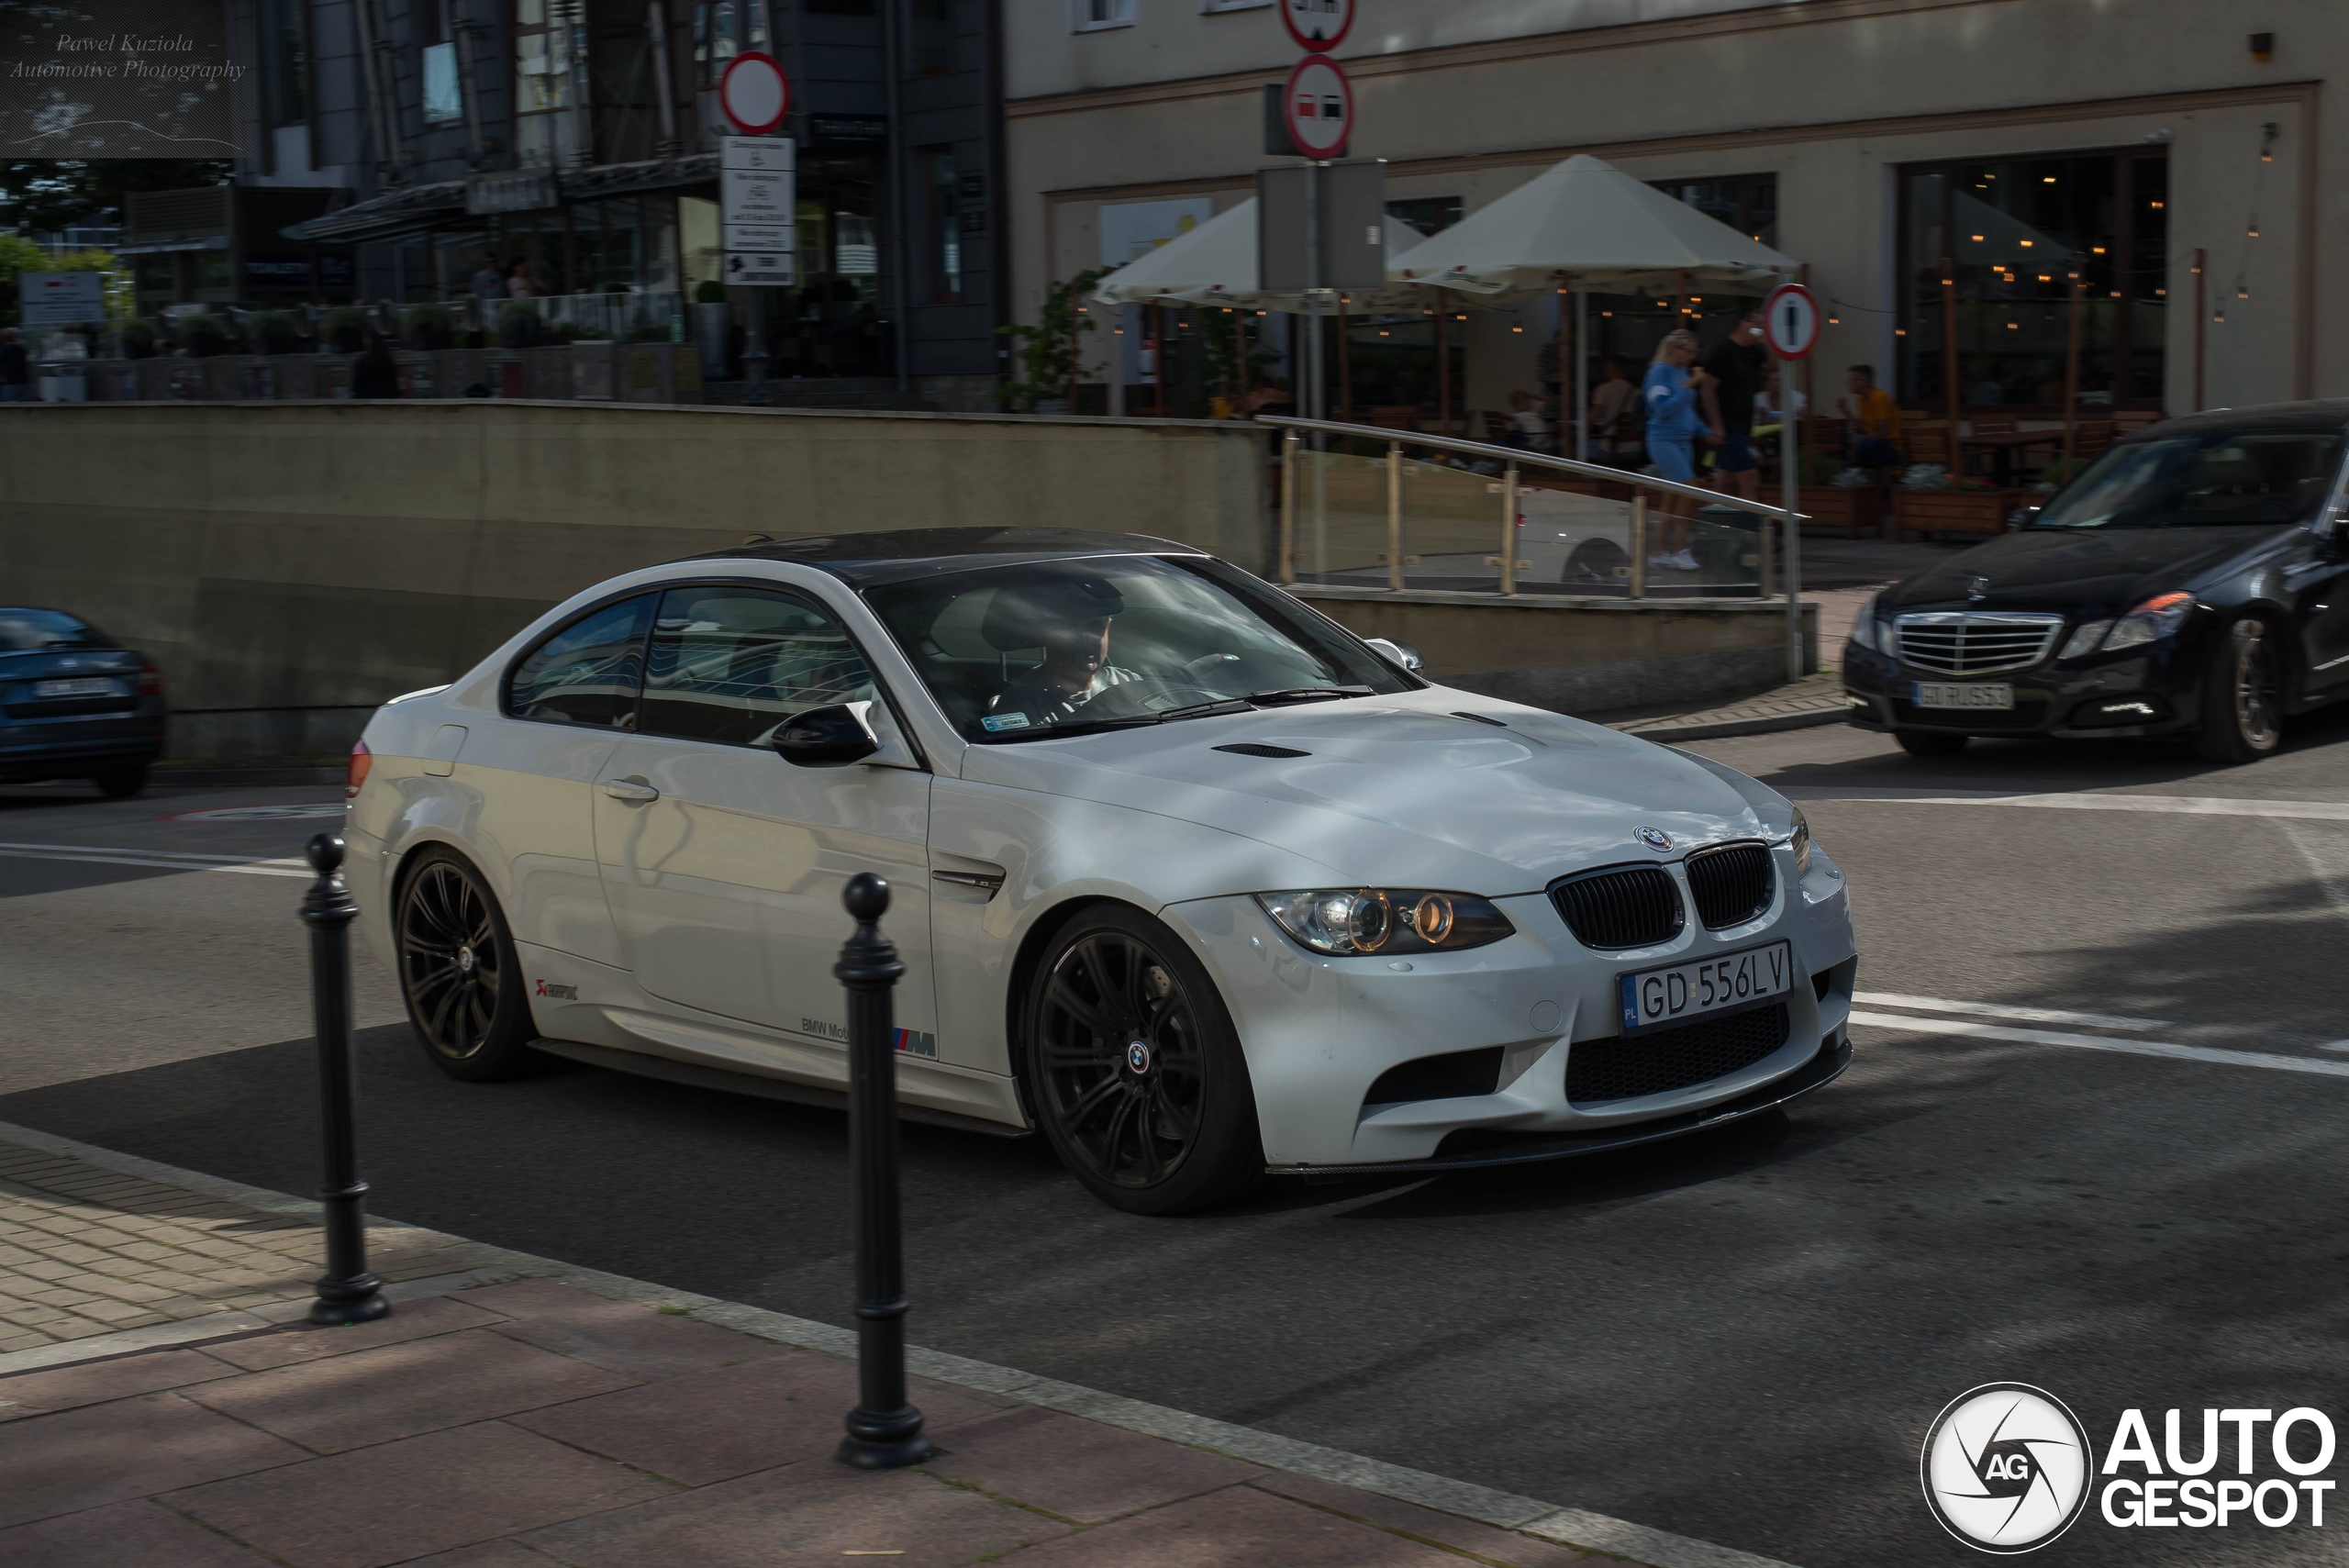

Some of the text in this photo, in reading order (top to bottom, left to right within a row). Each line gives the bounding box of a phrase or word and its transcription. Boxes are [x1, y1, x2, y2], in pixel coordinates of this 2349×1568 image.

[1642, 948, 1783, 1018] GD 556LV
[1625, 1007, 1636, 1020] PL
[802, 1018, 827, 1035] BMW
